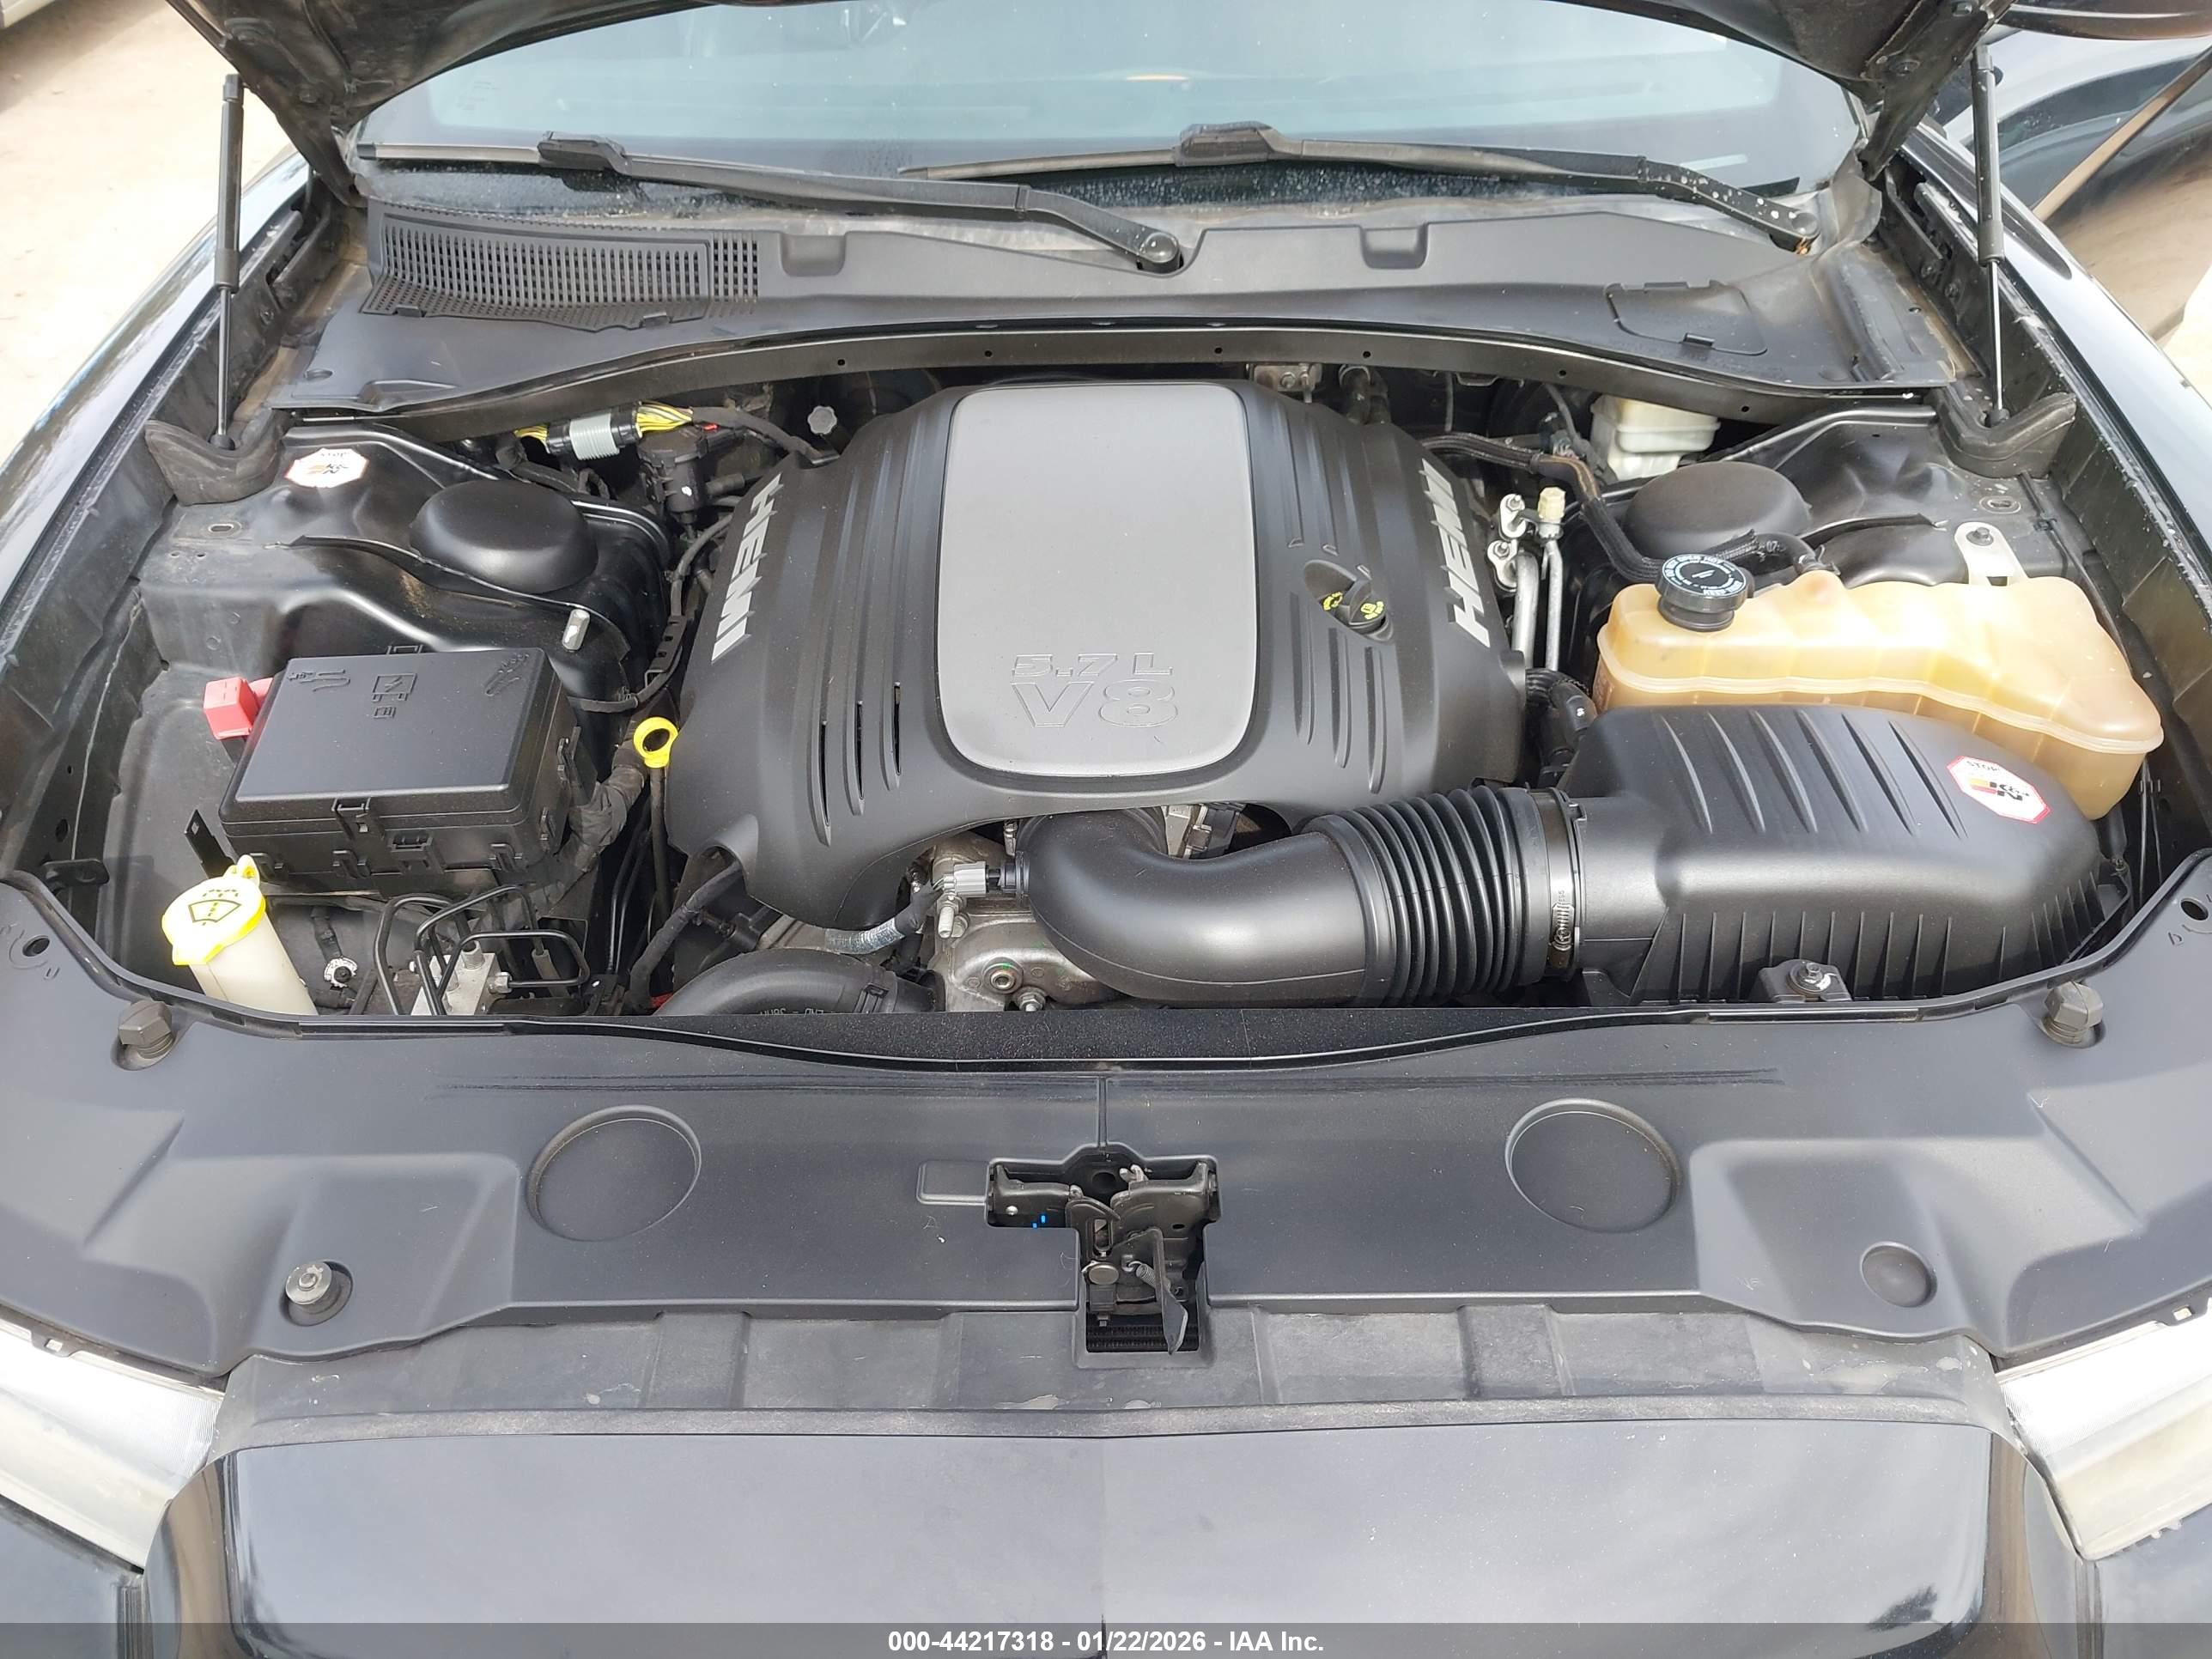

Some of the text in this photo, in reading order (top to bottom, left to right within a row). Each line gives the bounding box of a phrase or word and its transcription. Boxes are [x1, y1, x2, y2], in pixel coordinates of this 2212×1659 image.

[711, 473, 782, 664] HEMI
[1419, 458, 1491, 648] HEMI
[1011, 678, 1179, 728] V8
